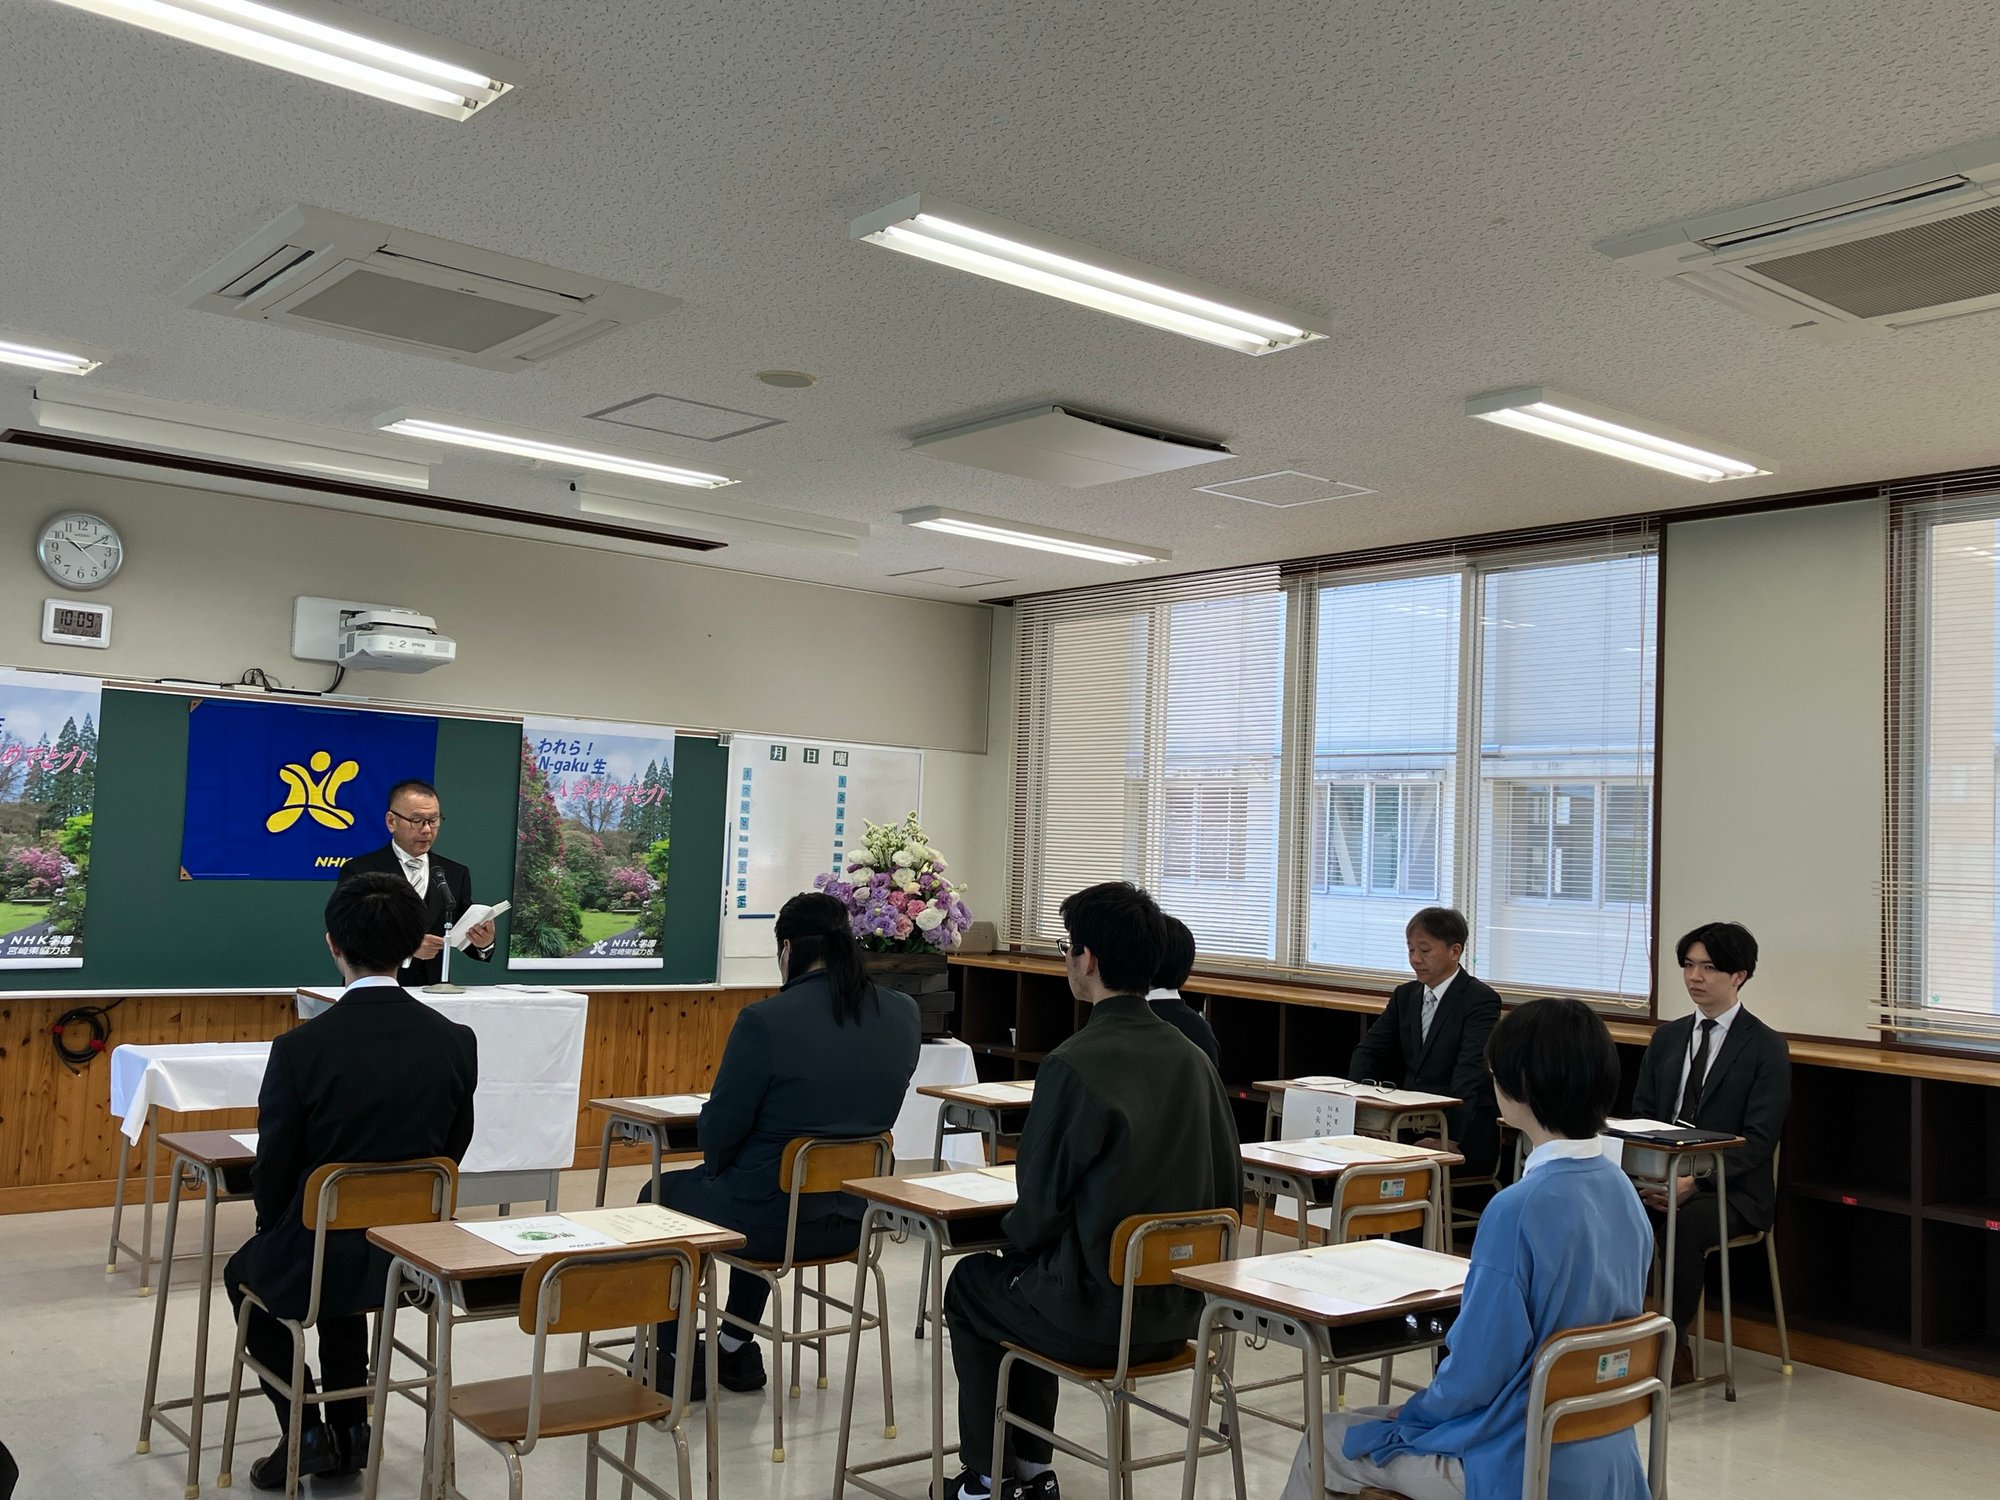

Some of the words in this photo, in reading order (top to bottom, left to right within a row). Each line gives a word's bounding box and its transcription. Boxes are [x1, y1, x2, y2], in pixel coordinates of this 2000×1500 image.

[65, 522, 73, 533] 11
[77, 520, 89, 531] 12
[54, 531, 65, 540] 10
[51, 541, 59, 552] 9
[104, 547, 112, 557] 3
[54, 555, 62, 565] 8
[63, 564, 71, 575] 7
[77, 567, 85, 579] 6
[90, 566, 98, 577] 5
[60, 610, 94, 628] 10:09
[399, 639, 407, 648] 2
[538, 738, 593, 755] われら！
[772, 746, 783, 760] 月
[807, 749, 816, 763] 日
[538, 756, 589, 774] N-gaku
[591, 758, 607, 775] 生
[10, 934, 74, 947] NHK学園
[612, 939, 657, 948] NHK学園
[7, 946, 72, 955] 宮崎東協力校
